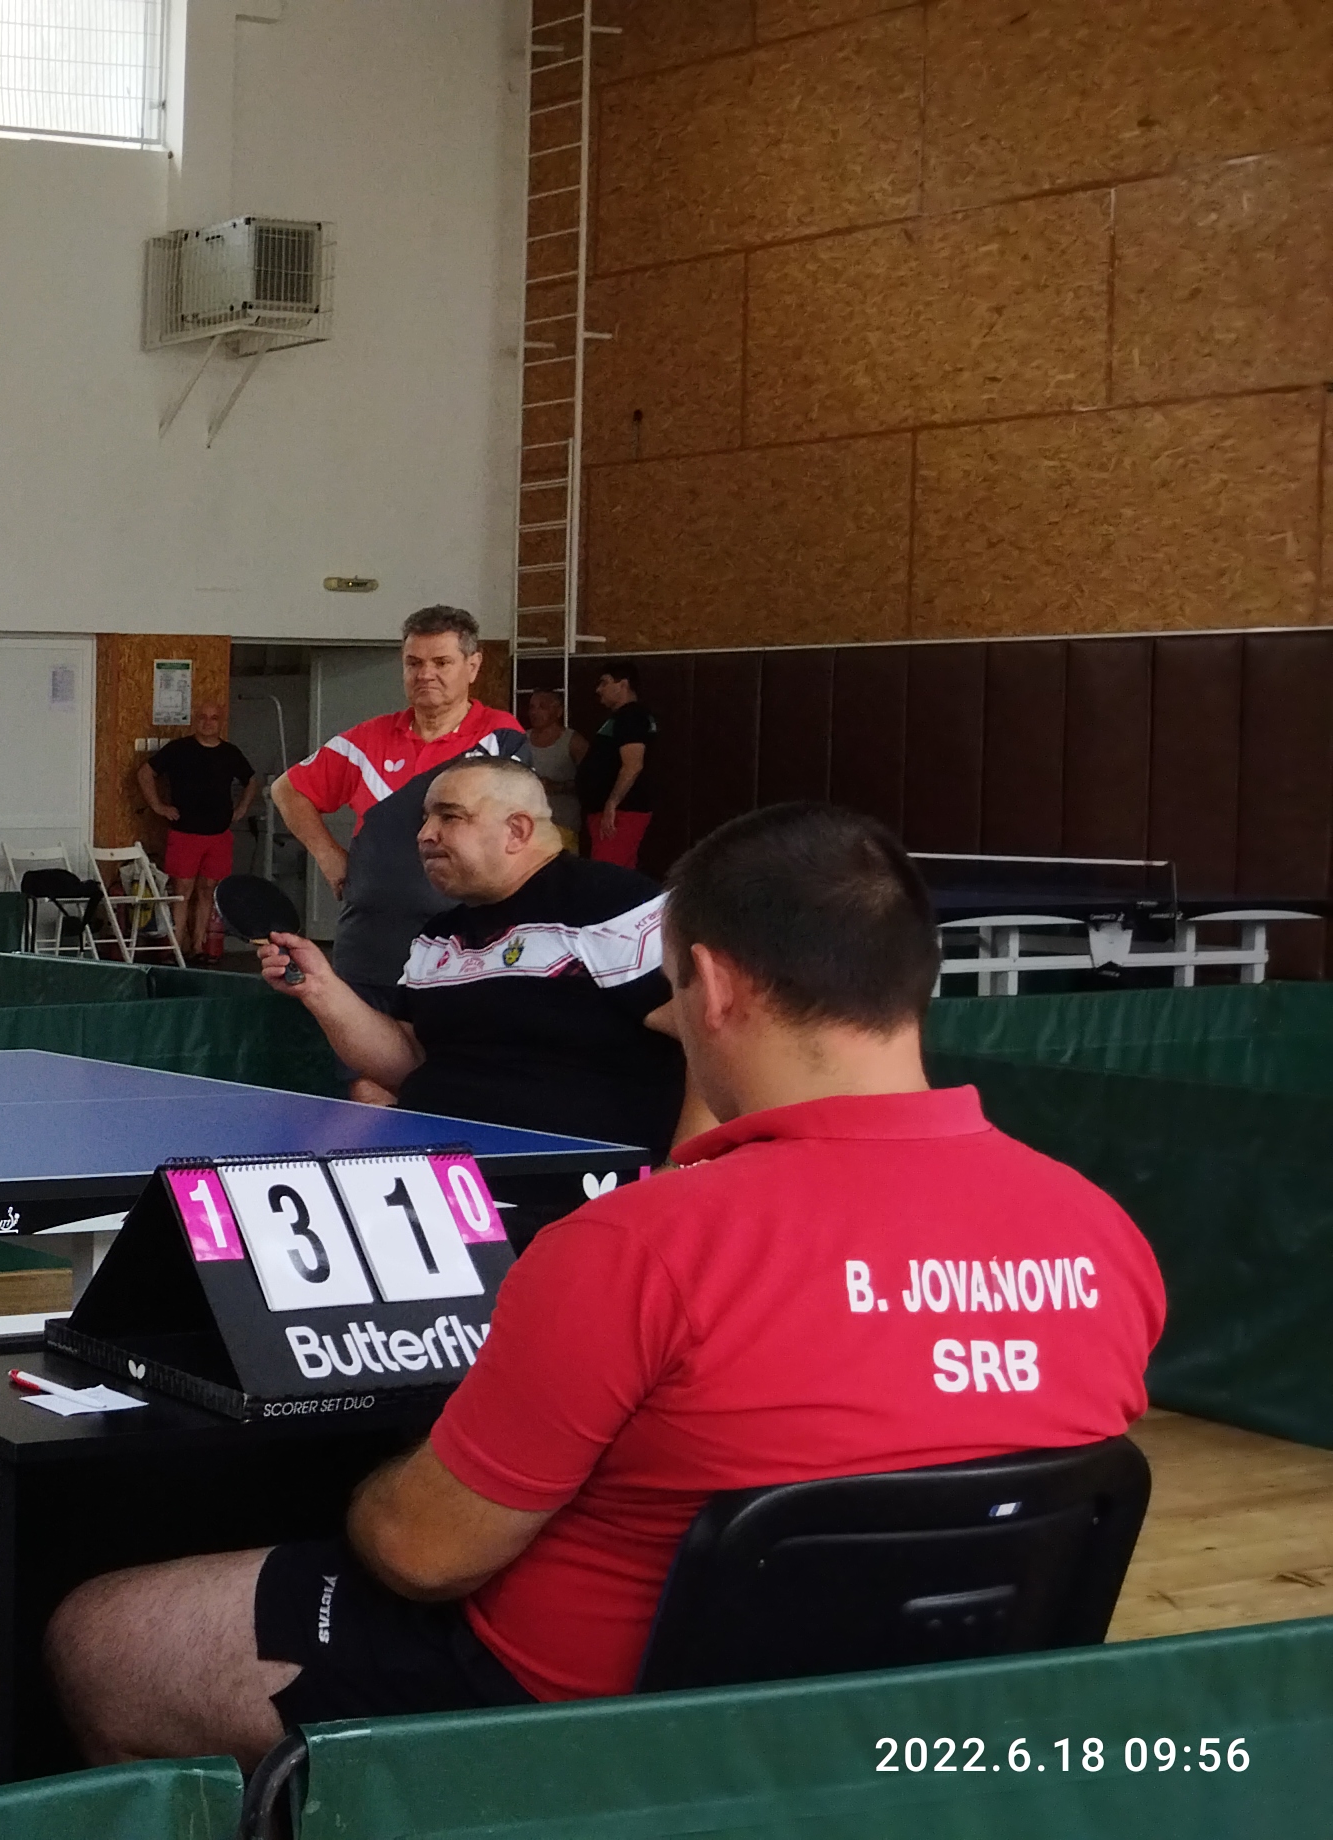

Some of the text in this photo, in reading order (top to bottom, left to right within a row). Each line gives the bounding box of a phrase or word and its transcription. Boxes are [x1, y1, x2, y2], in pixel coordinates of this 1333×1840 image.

[189, 1165, 492, 1284] 1 3 1 0
[845, 1256, 1099, 1313] B. JOVANOVIC
[932, 1338, 1040, 1393] SRB
[263, 1395, 376, 1418] SCORER SET DUO
[318, 1574, 339, 1644] VICTAS
